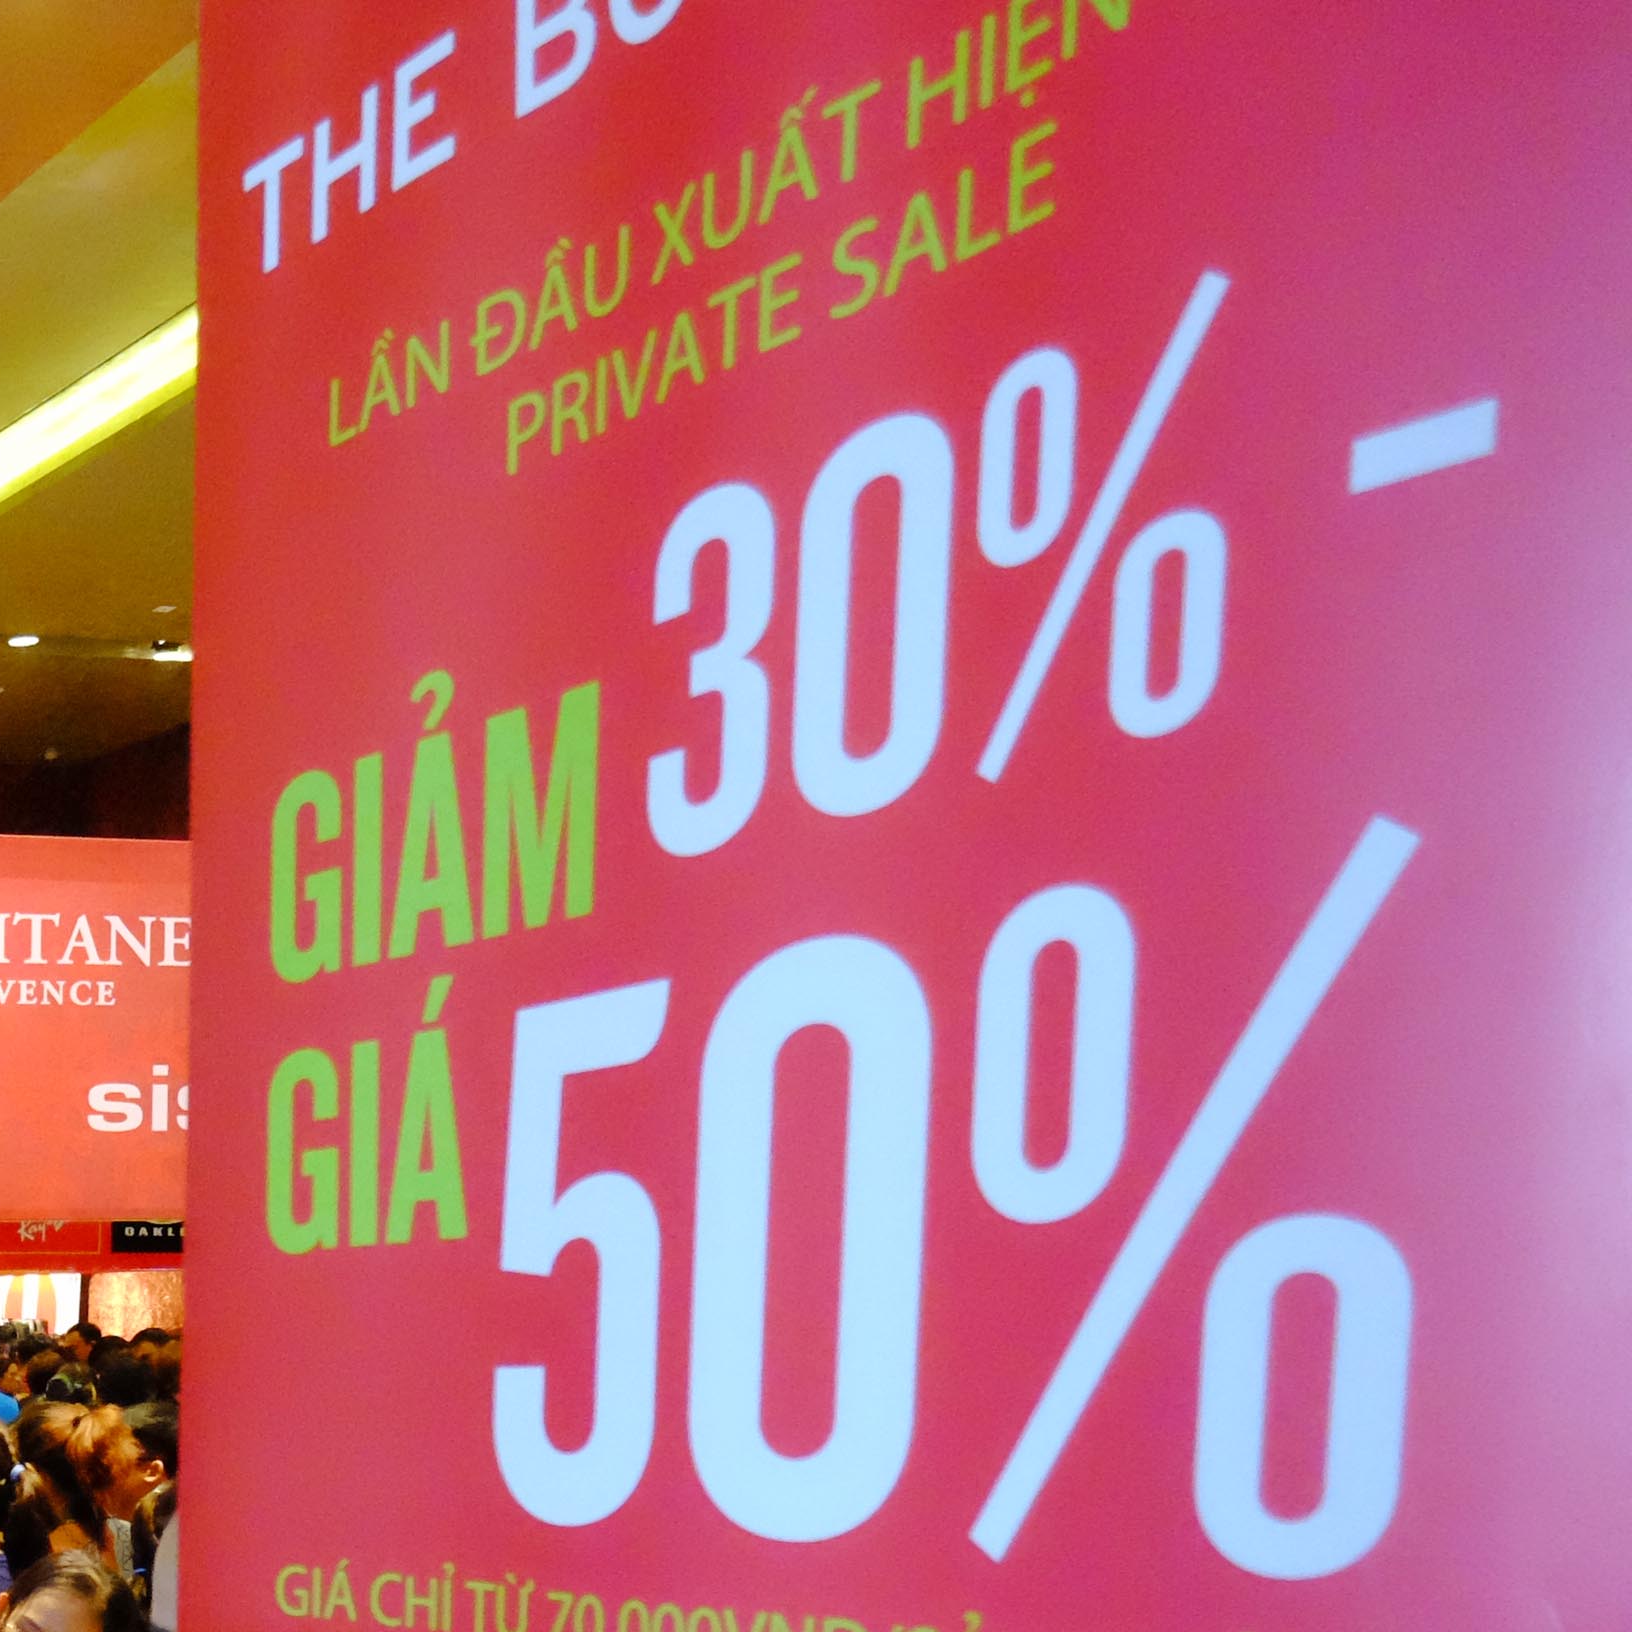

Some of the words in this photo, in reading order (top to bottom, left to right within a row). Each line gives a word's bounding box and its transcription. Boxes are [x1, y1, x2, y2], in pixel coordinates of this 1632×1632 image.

[242, 28, 457, 274] THE
[329, 319, 450, 447] LẦN
[470, 224, 632, 377] ĐẦU
[650, 79, 883, 286] XUẤT
[505, 252, 803, 477] PRIVATE
[828, 118, 1058, 320] SALE
[268, 668, 603, 984] GIẢM
[644, 267, 1232, 860] 30%
[86, 1063, 190, 1132] si
[264, 974, 470, 1256] GIÁ
[489, 811, 1423, 1583] 50%
[274, 1558, 357, 1622] GIÁ
[369, 1561, 456, 1632] CHỈ
